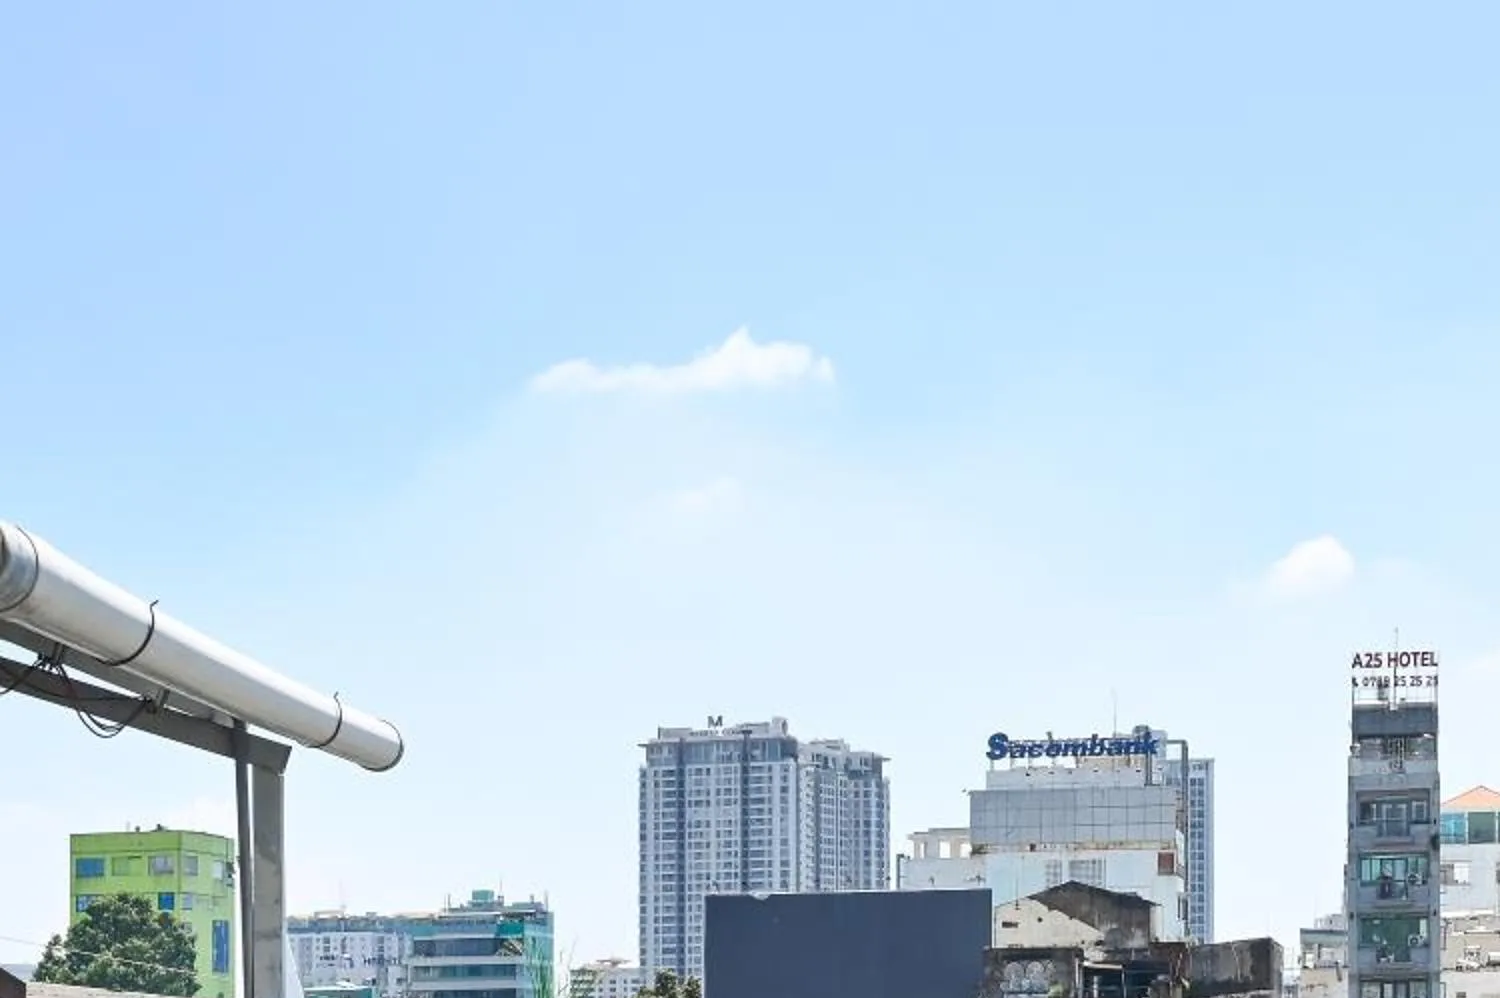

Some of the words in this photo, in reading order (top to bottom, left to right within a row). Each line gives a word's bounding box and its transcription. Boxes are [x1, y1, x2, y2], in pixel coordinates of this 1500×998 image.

[1352, 653, 1383, 669] A25
[1387, 651, 1438, 668] HOTEL
[708, 715, 723, 728] M
